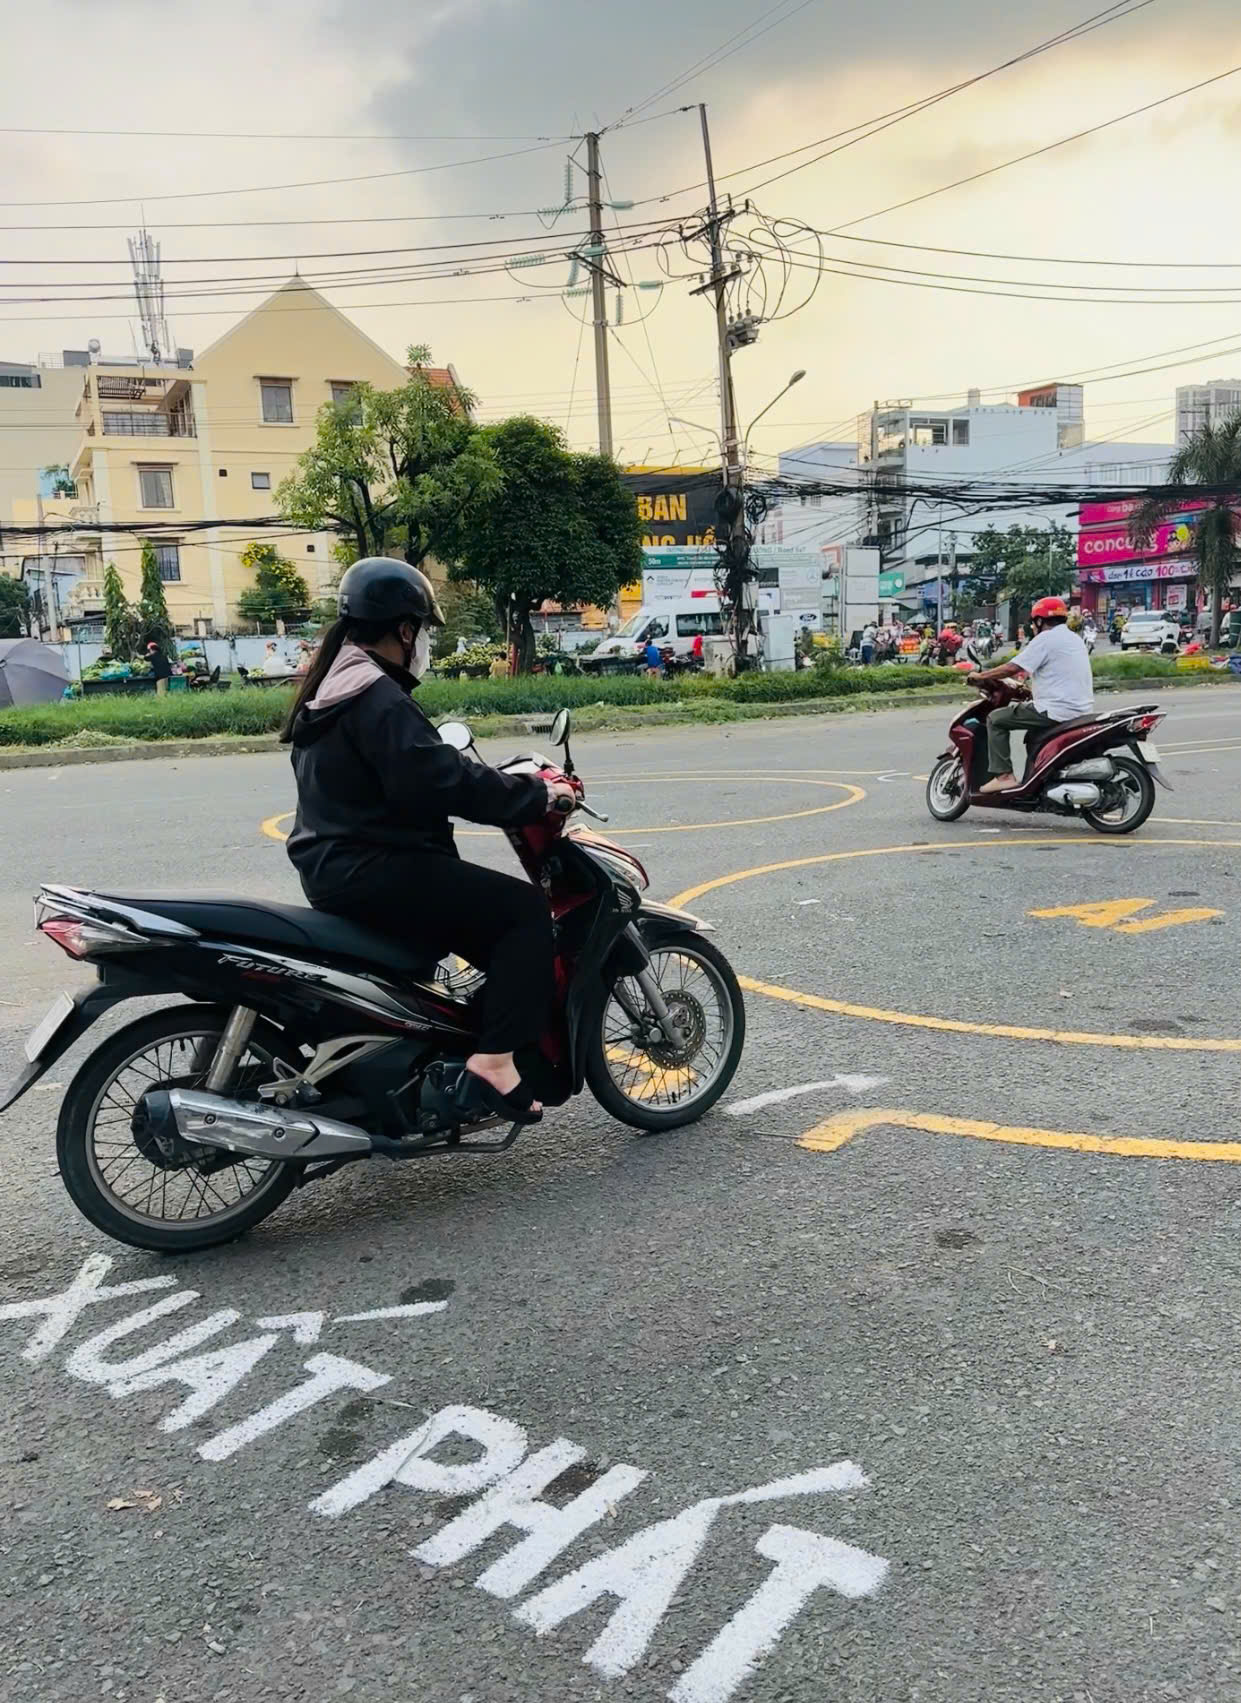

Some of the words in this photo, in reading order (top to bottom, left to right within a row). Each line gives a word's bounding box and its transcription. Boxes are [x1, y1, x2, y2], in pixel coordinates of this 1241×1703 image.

[217, 952, 327, 981] FUTURE
[0, 1252, 448, 1461] XUẤT
[307, 1404, 890, 1703] PHÁT
